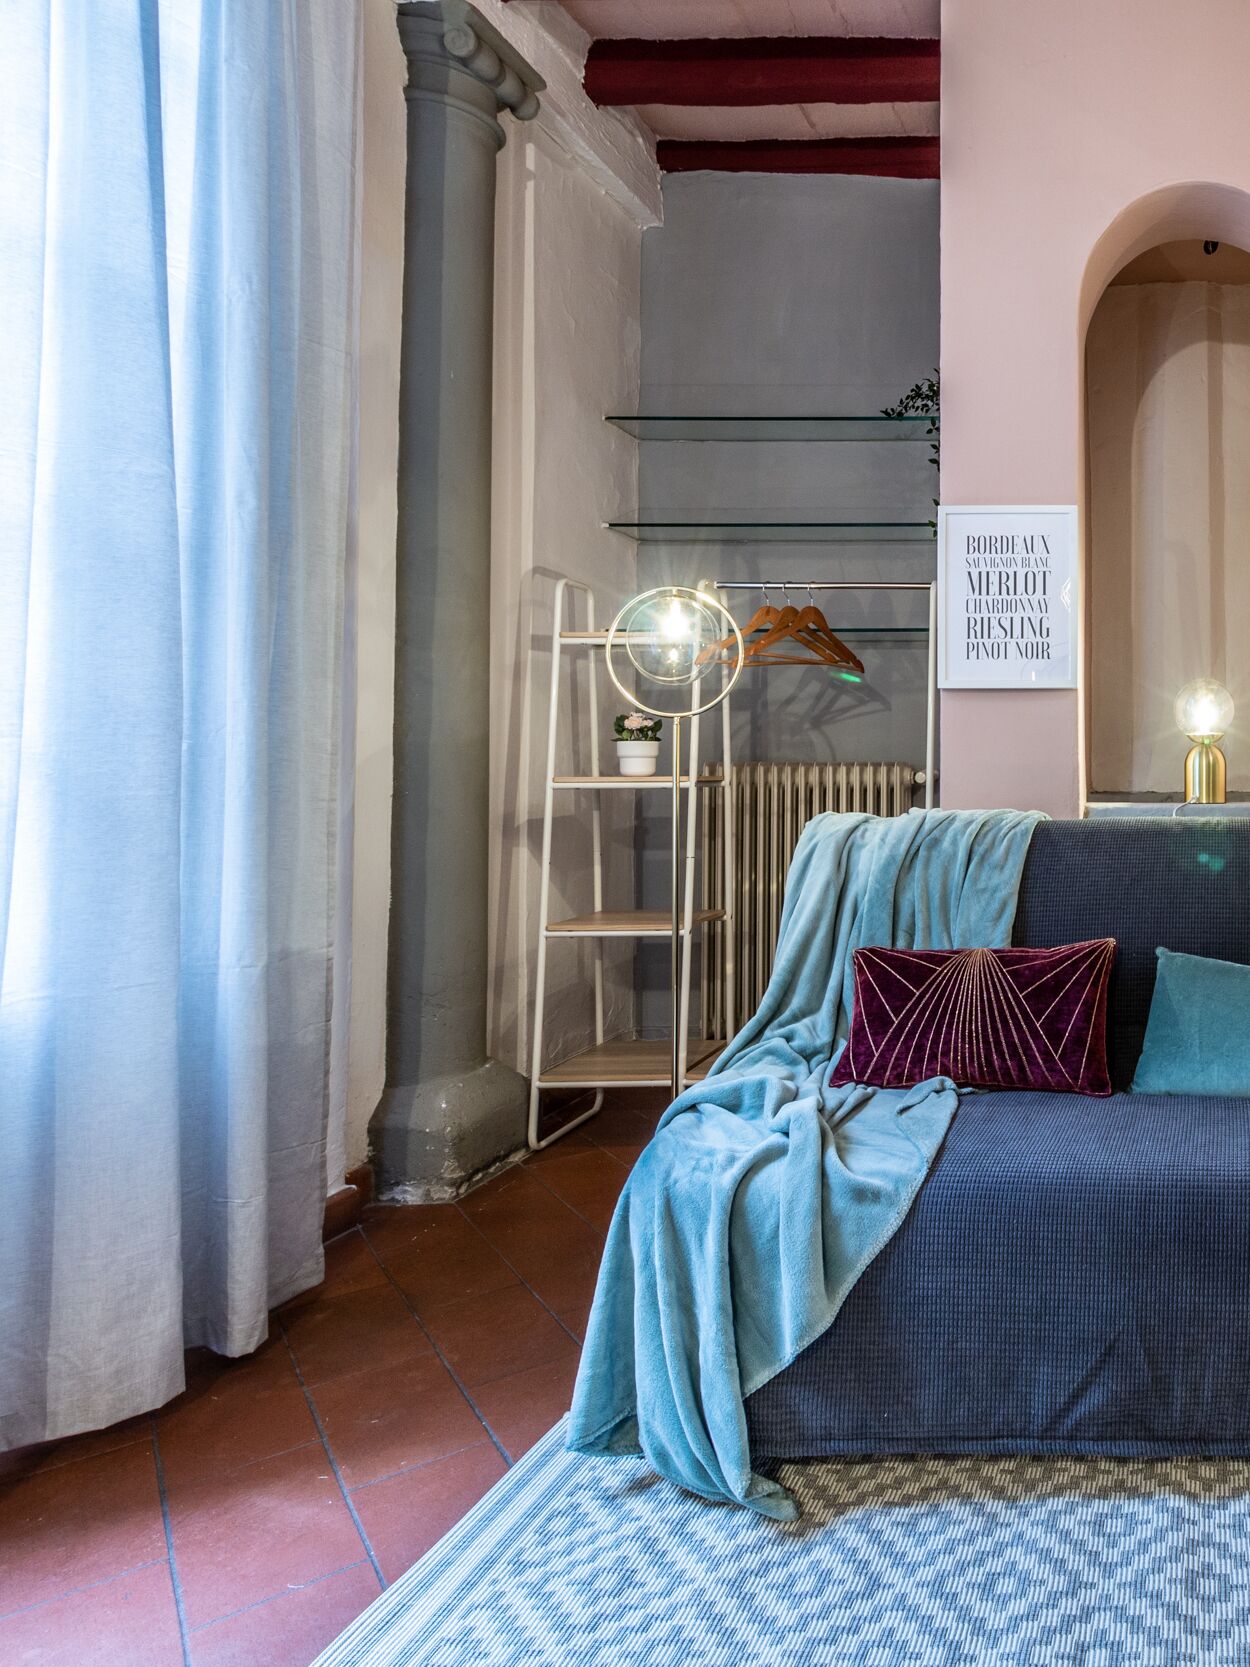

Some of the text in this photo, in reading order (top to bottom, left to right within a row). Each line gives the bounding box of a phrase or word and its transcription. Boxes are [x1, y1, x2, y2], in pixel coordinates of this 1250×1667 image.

[966, 535, 1050, 554] BORDEAUX
[965, 557, 1050, 569] SAUVIGNON BLANC
[966, 570, 1051, 596] MERLOT
[965, 598, 1050, 614] CHARDONNAY
[967, 616, 1050, 640] RIESLING
[966, 641, 1050, 660] PINOT NOIR
